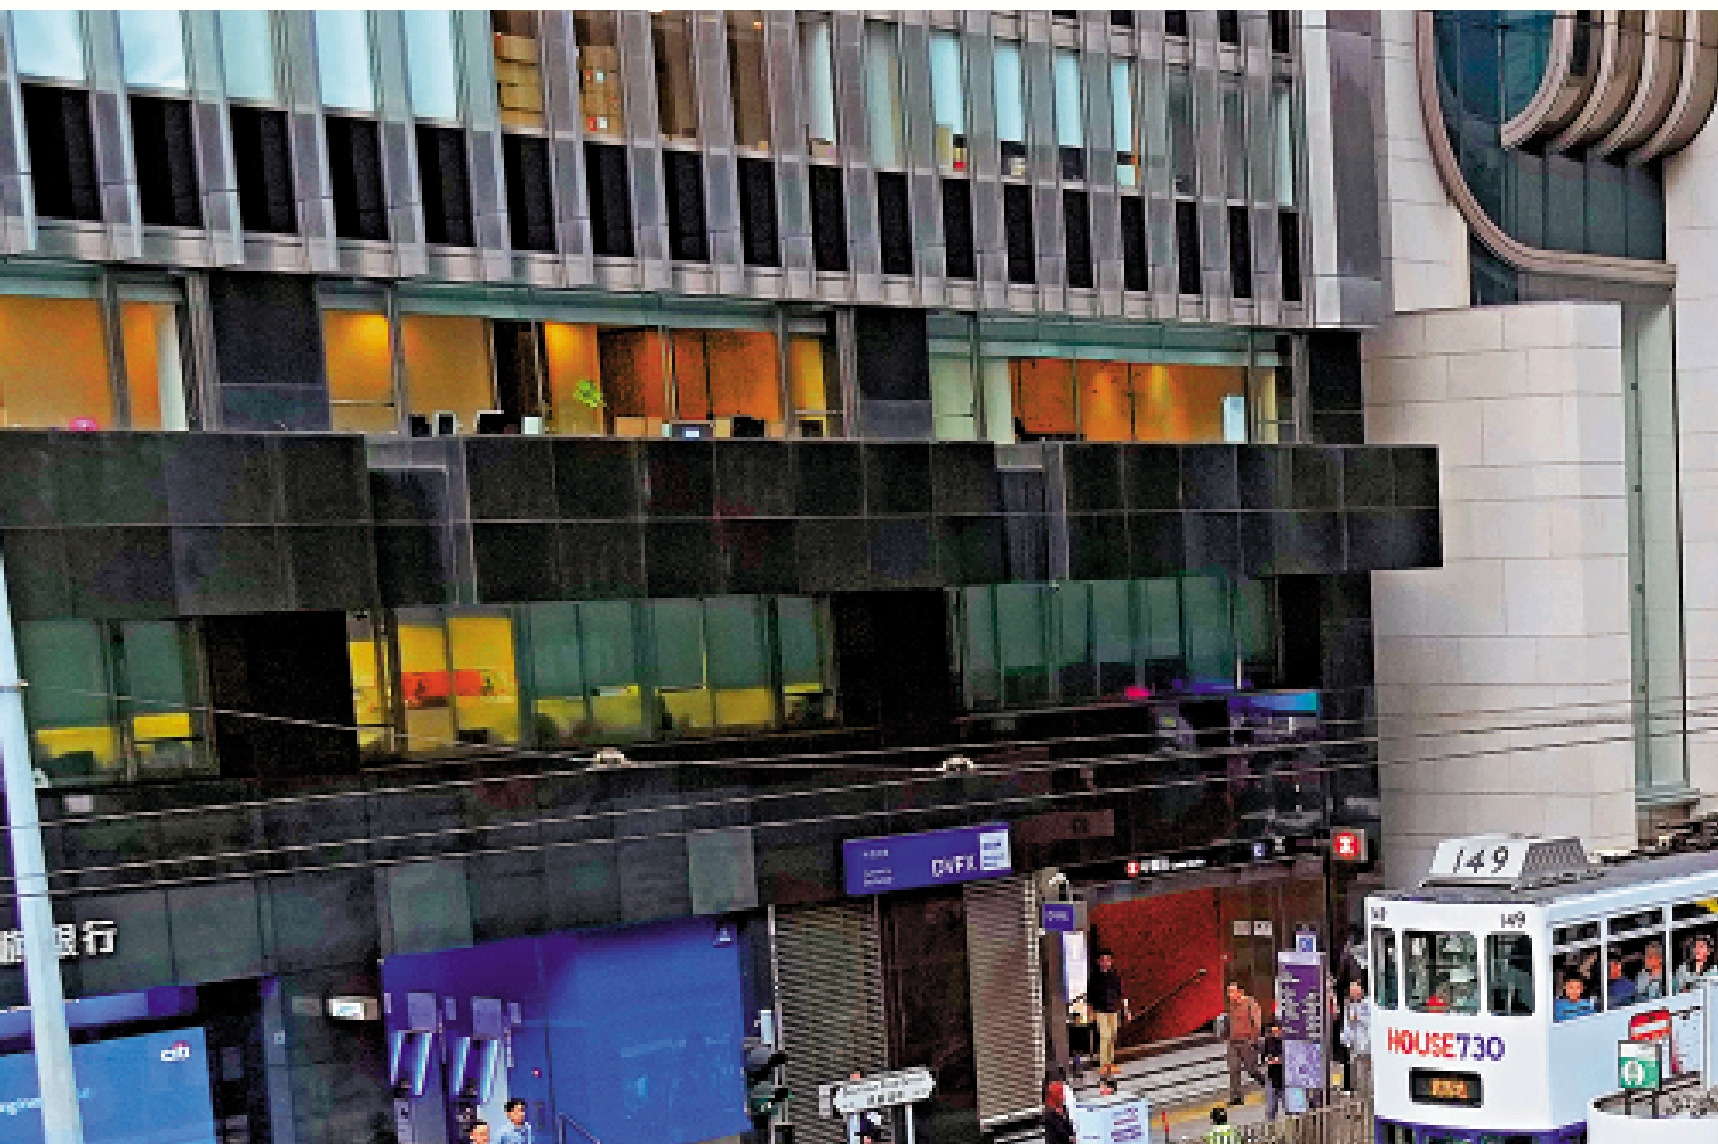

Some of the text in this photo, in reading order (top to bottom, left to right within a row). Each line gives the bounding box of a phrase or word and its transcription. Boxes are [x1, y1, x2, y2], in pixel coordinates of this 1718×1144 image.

[1451, 845, 1509, 874] 149
[1500, 909, 1526, 929] 149
[1387, 1026, 1506, 1062] HOUSE730
